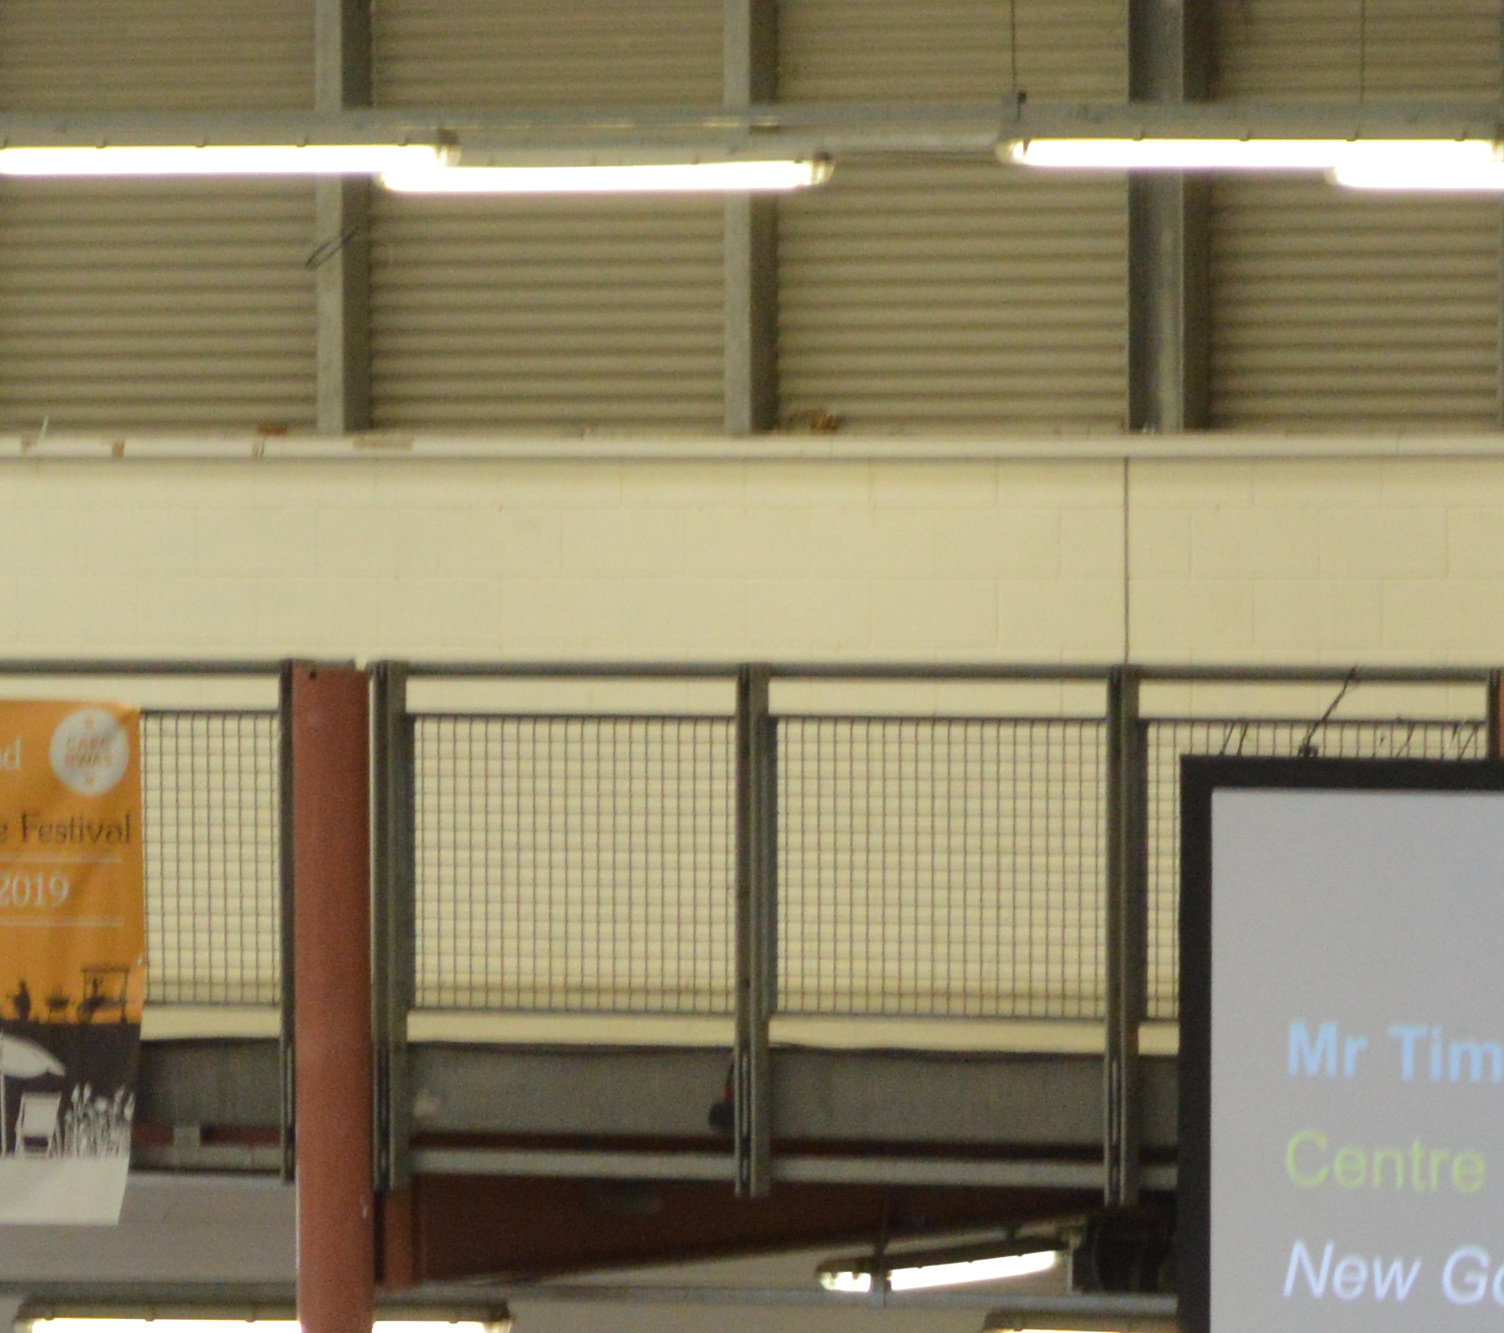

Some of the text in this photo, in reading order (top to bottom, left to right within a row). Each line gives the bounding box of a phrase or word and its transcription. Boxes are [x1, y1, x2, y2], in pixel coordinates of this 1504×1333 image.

[21, 811, 132, 843] Festival
[1287, 1022, 1368, 1079] Mr
[1388, 1023, 1504, 1085] Tim
[1285, 1130, 1487, 1195] Centre
[1283, 1240, 1420, 1302] New
